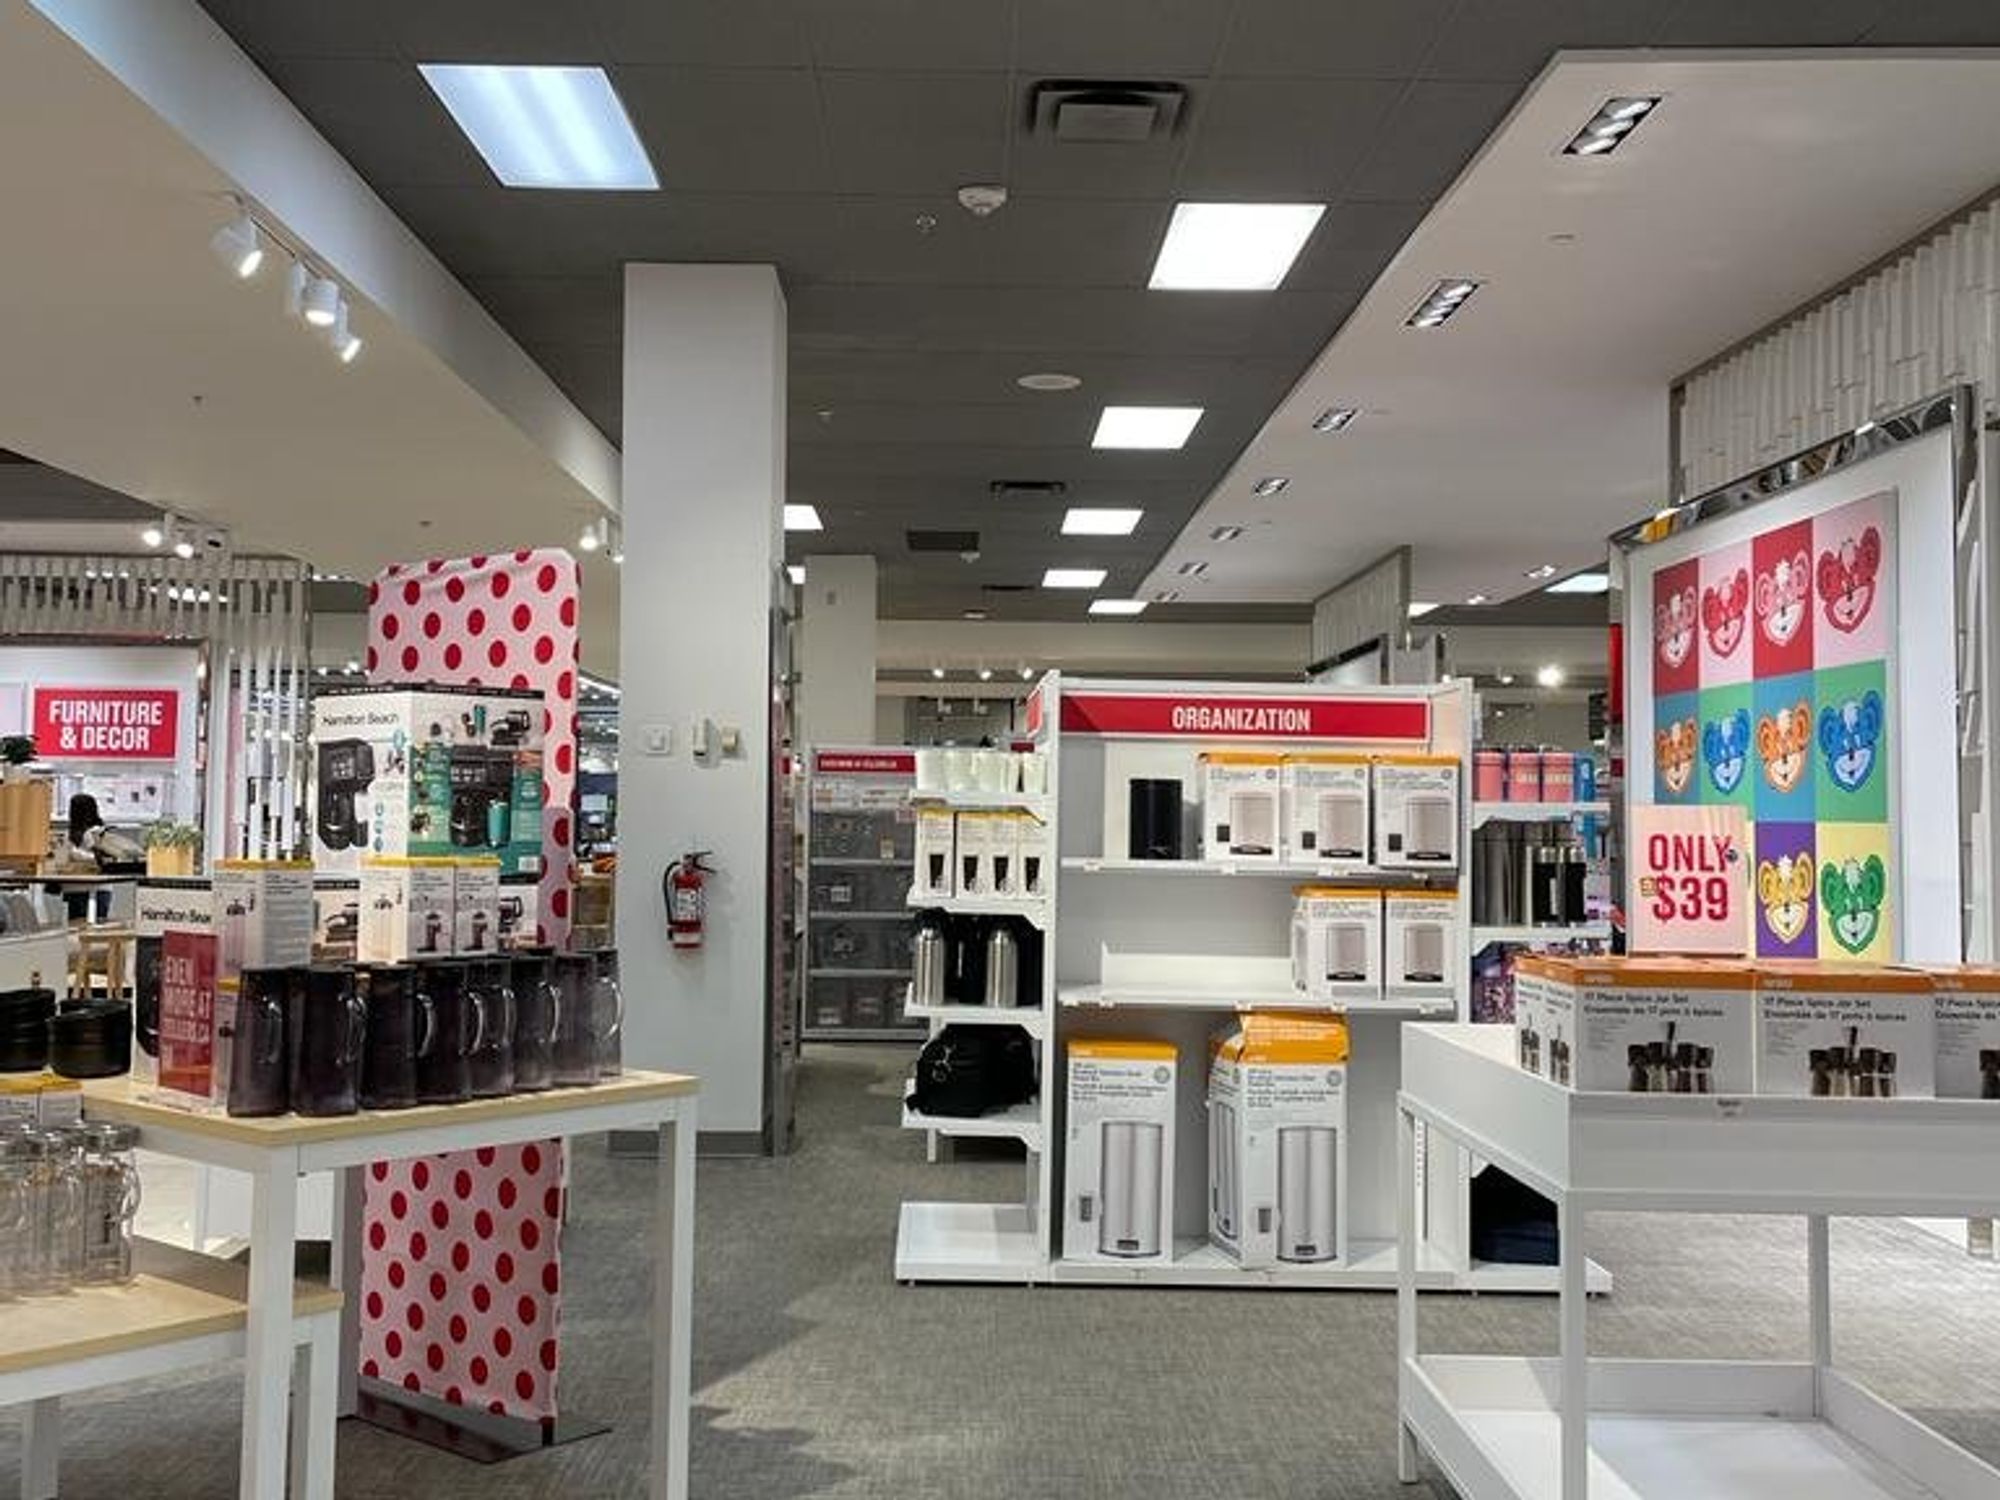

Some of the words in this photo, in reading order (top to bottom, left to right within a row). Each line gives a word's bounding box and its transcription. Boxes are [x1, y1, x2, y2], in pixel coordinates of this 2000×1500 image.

[49, 700, 164, 725] FURNITURE
[321, 711, 366, 726] Hamilton
[368, 711, 400, 726] Beach
[1171, 705, 1311, 731] ORGANIZATION
[60, 726, 78, 750] &
[82, 726, 150, 750] DECOR
[1649, 834, 1733, 872] ONLY
[1652, 874, 1728, 924] $39
[141, 906, 186, 922] Hamilton
[1855, 999, 1871, 1008] Set
